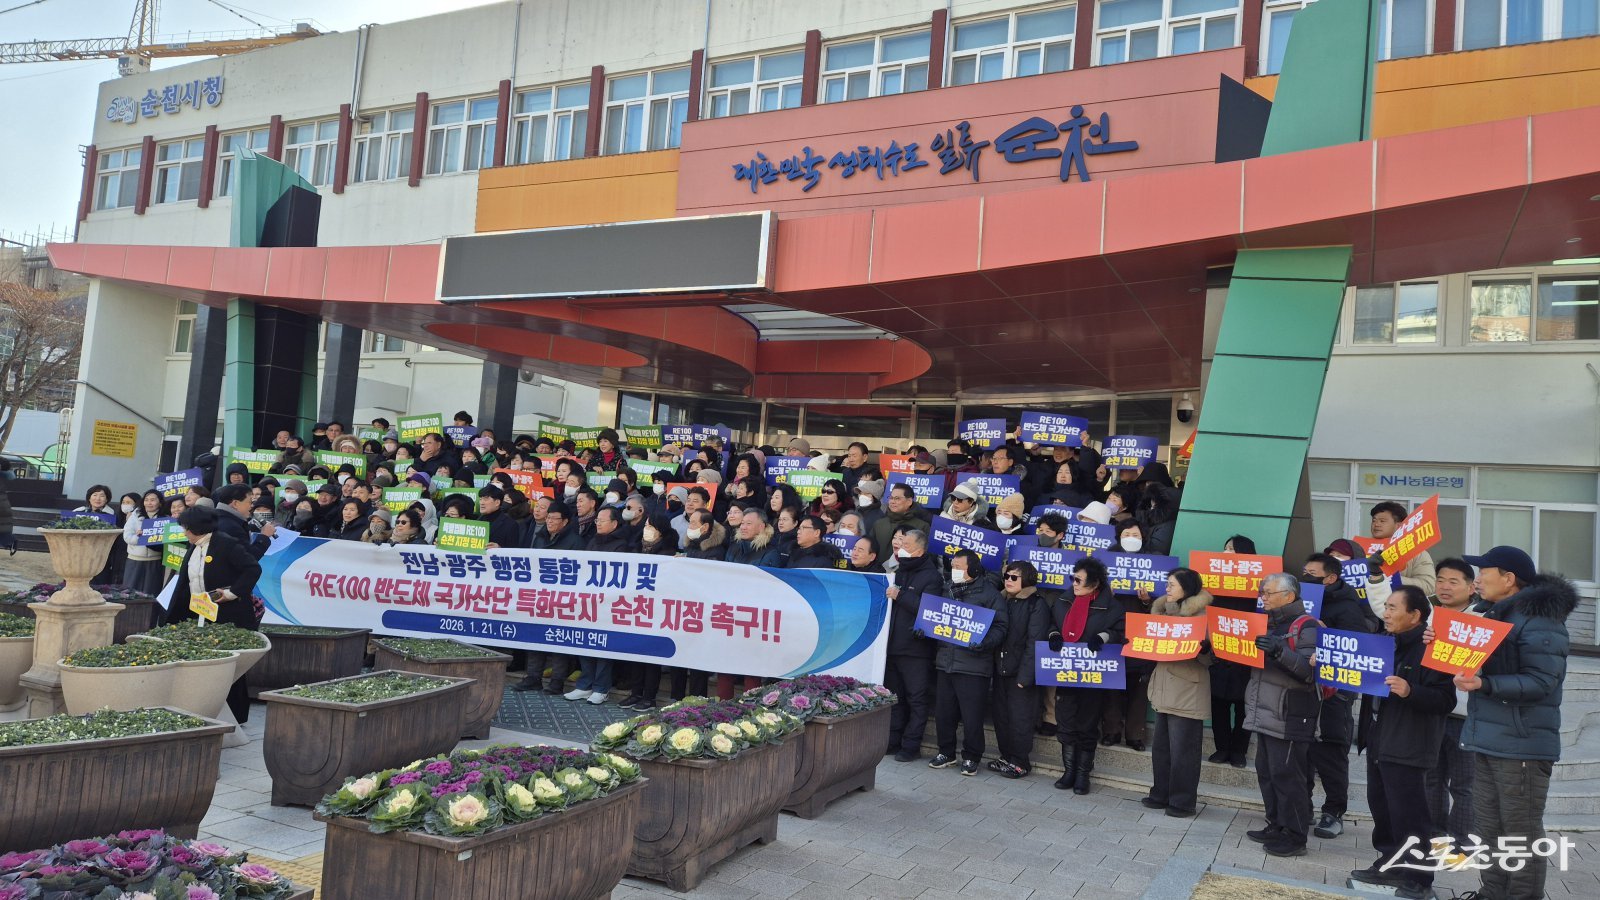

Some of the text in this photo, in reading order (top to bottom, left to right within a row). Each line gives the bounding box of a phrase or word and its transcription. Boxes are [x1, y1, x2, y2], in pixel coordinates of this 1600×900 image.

[140, 75, 224, 117] 순천시청
[732, 104, 1139, 193] 대한민국 생태수도 일류 순천
[967, 422, 988, 431] RE100
[1039, 416, 1067, 425] RE100
[641, 429, 659, 437] RE100
[702, 427, 718, 435] RE100
[973, 430, 1001, 439] 국가산단
[1023, 423, 1081, 435] 반도체 국가산단
[1032, 433, 1067, 443] 순천 지정
[1111, 439, 1137, 447] RE100
[1118, 448, 1153, 458] 국가산단
[343, 456, 363, 466] RE100
[778, 459, 800, 467] RE100
[1105, 457, 1138, 466] 순천 지정
[165, 473, 187, 483] RE100
[905, 477, 929, 485] RE100
[977, 477, 1002, 486] RE100
[1380, 474, 1464, 489] NH농협은행
[802, 486, 818, 496] 지정
[985, 486, 1016, 496] 국가산단
[916, 495, 929, 505] 지정
[466, 525, 486, 537] RE100
[952, 524, 984, 540] RE100
[1066, 524, 1096, 536] RE100
[441, 535, 485, 549] 순천 지정 명시
[934, 530, 999, 556] 반도체 국가산단
[1075, 535, 1111, 549] 국가산단
[1380, 544, 1399, 566] 행정
[1397, 533, 1416, 556] 통합
[1415, 520, 1435, 544] 지지
[1029, 550, 1062, 562] RE100
[1116, 557, 1152, 569] RE100
[1209, 558, 1262, 575] 전남·광주
[400, 551, 658, 591] 전남·광주 행정 통합 지지 및
[1107, 567, 1127, 579] 도체
[1045, 573, 1064, 585] 지정
[1110, 580, 1131, 590] 순천
[1223, 575, 1248, 591] 통합
[374, 577, 431, 608] 반도체
[434, 582, 512, 615] 국가산단
[611, 594, 654, 628] 순천
[660, 599, 704, 634] 지정
[711, 602, 782, 643] 촉구!!
[942, 602, 973, 619] RE100
[439, 618, 517, 638] 2026. 1. 21. (수)
[922, 609, 985, 634] 반도체 국가산단
[1217, 615, 1248, 637] 전남·광주
[933, 624, 972, 643] 순천 지정
[1146, 621, 1192, 638] 전남·광주
[1448, 620, 1494, 648] 전남·광주
[544, 629, 607, 648] 순천시민 연대
[1212, 632, 1258, 658] 행정 통합 지지
[1322, 633, 1358, 652] RE100
[1132, 636, 1199, 655] 행정 통합 지지
[1060, 647, 1097, 659] RE100
[1431, 639, 1487, 669] 행정 통합 지지
[1040, 658, 1119, 672] 반도체 국가산단
[1332, 650, 1385, 673] 국가산단
[1056, 671, 1103, 684] 순천 지정
[1319, 664, 1362, 686] 순천 지정
